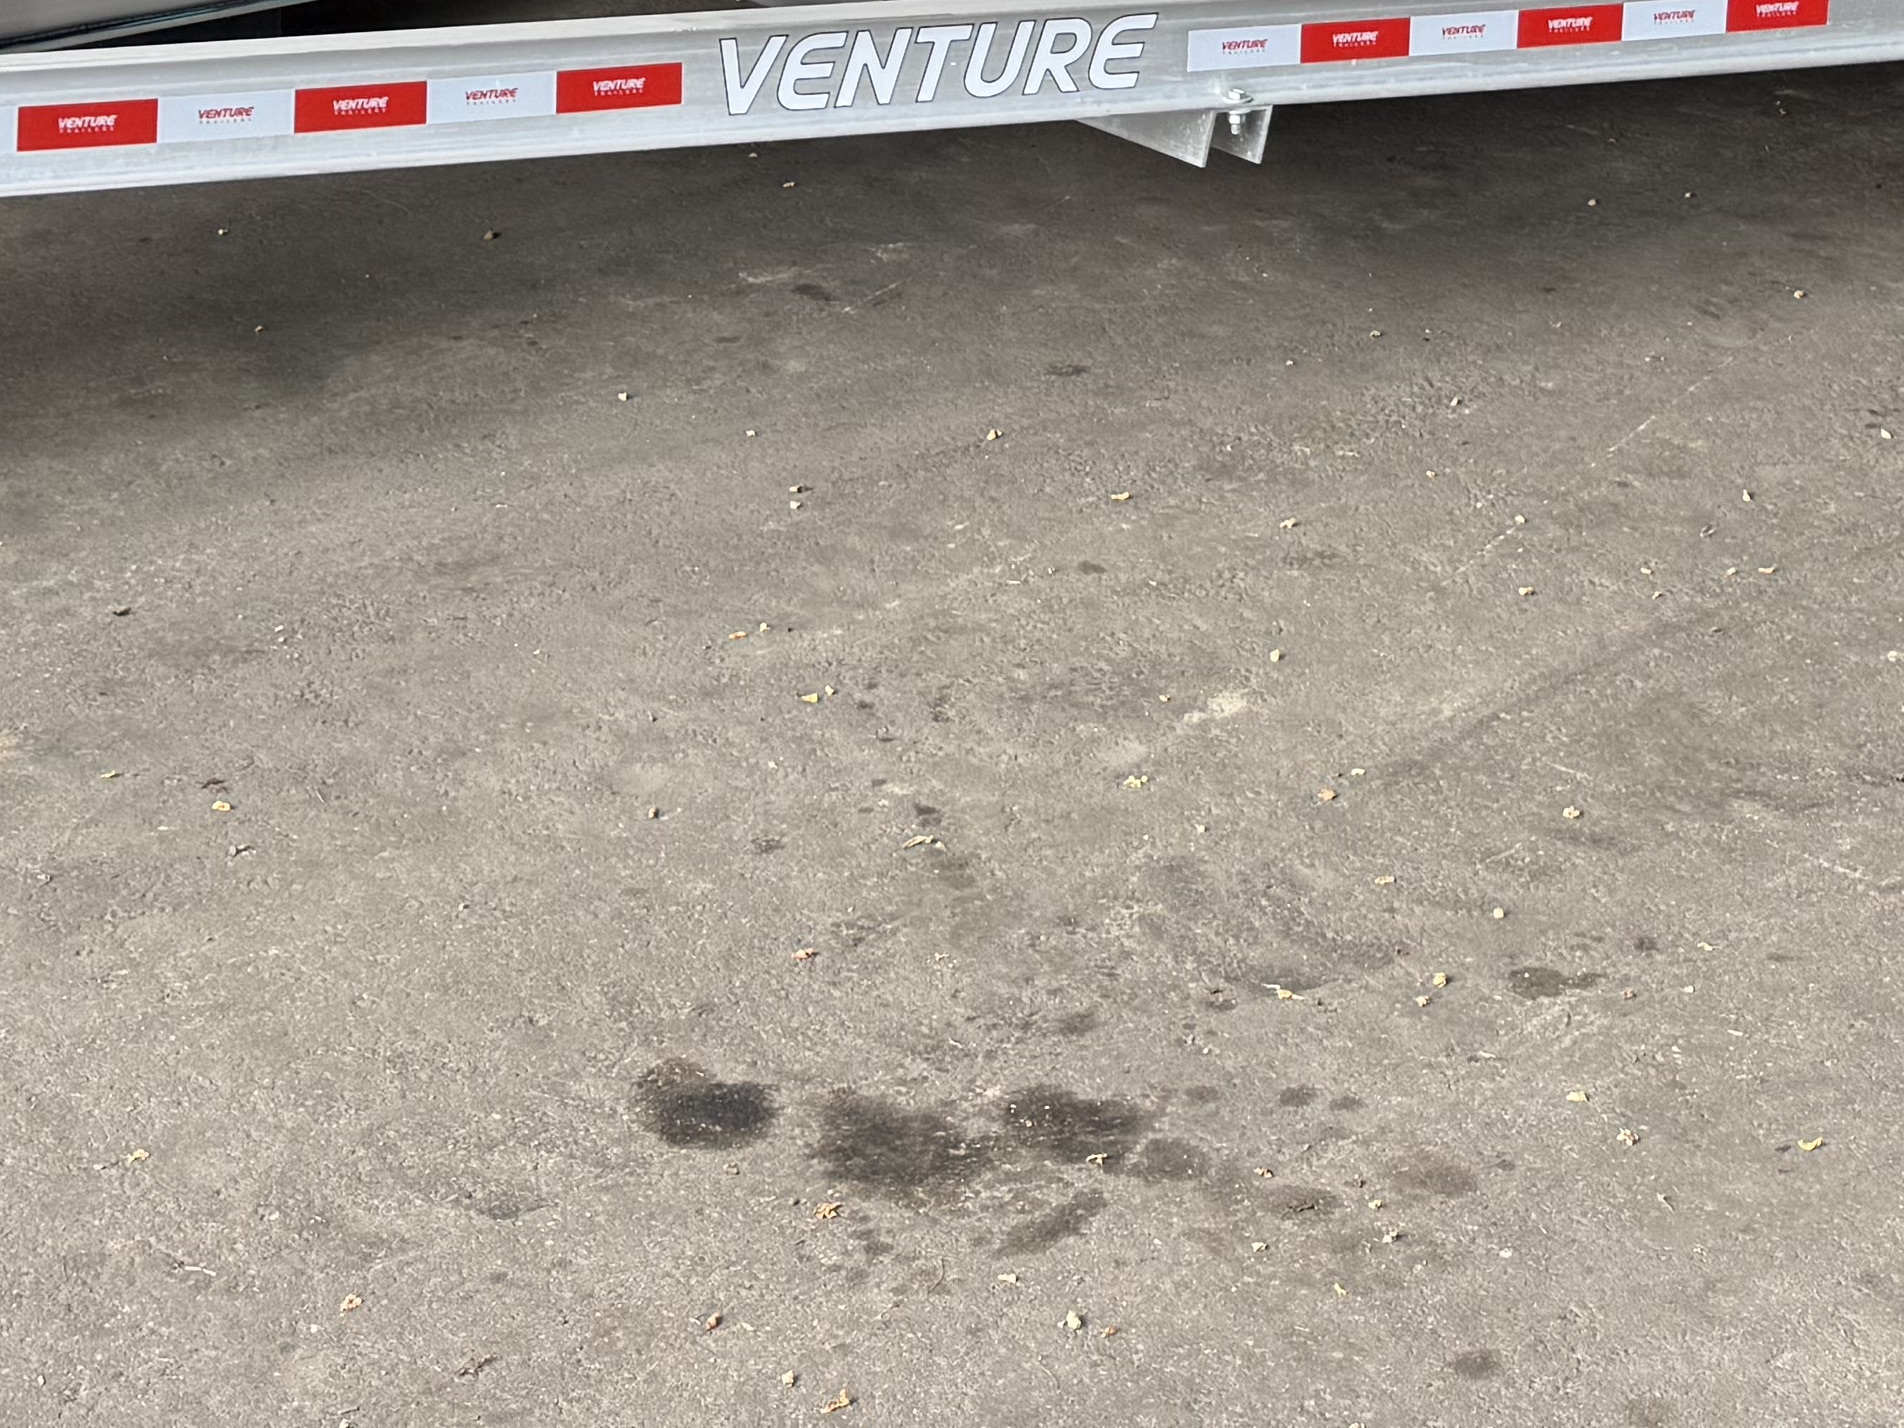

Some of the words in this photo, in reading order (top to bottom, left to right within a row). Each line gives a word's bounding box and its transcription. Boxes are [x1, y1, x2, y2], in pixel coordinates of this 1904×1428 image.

[719, 12, 1159, 116] VENTURE
[592, 77, 646, 91] VENTURE
[464, 87, 519, 100] VENTURE
[332, 96, 389, 111] VENTURE
[198, 106, 254, 119] VENTURE
[58, 114, 117, 129] VENTURE
